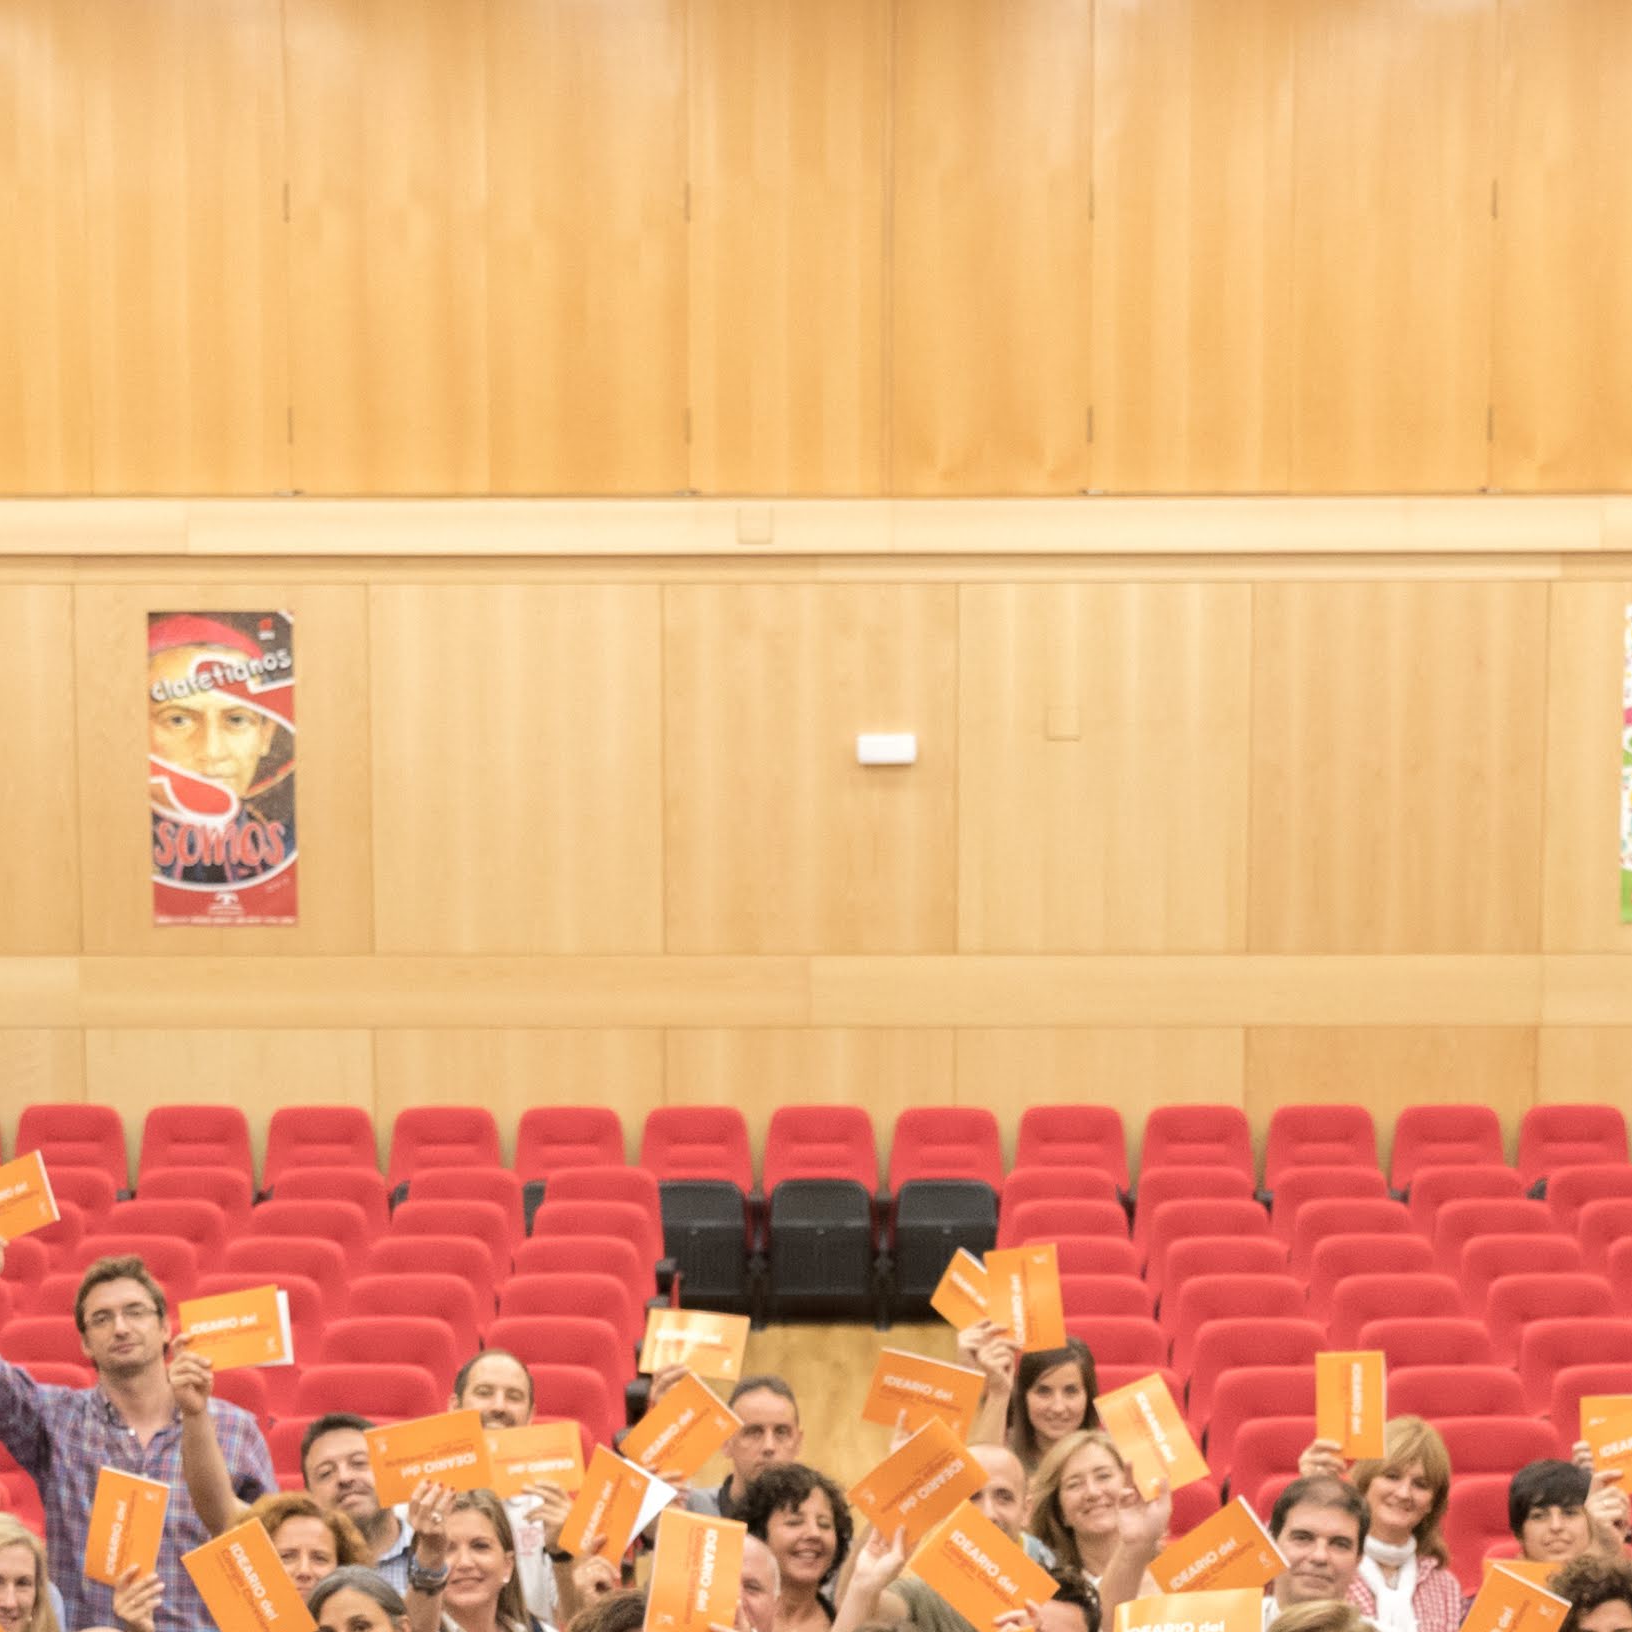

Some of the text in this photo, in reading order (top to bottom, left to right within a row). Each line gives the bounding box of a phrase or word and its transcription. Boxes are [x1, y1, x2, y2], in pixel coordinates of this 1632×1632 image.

[228, 1542, 279, 1622] IDEARIO del
[949, 1529, 1019, 1595] IDEARIO del
